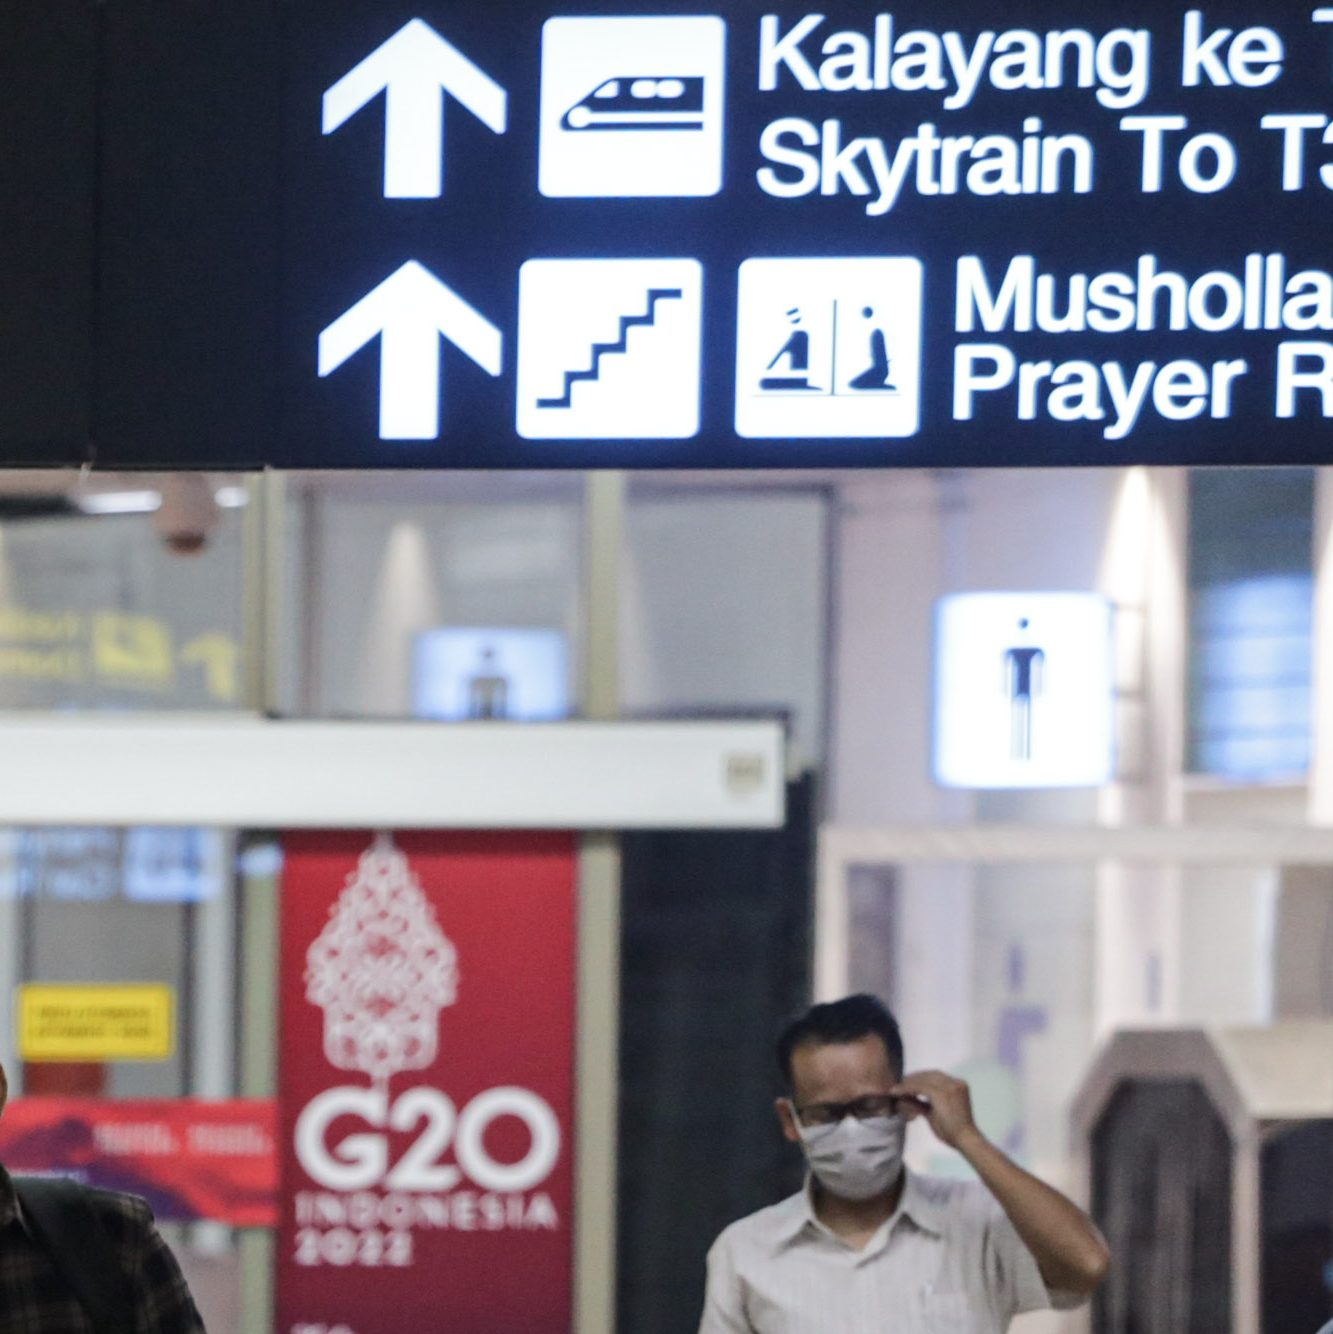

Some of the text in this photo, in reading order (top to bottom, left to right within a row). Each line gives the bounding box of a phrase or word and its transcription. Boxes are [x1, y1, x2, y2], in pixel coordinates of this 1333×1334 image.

[758, 12, 1152, 110] Kalayang
[1182, 9, 1284, 88] ke
[755, 113, 1333, 216] Skytrain To T
[954, 253, 1333, 333] Musholla
[952, 343, 1249, 440] Prayer
[293, 1085, 562, 1193] G20
[294, 1190, 559, 1232] INDONESIA
